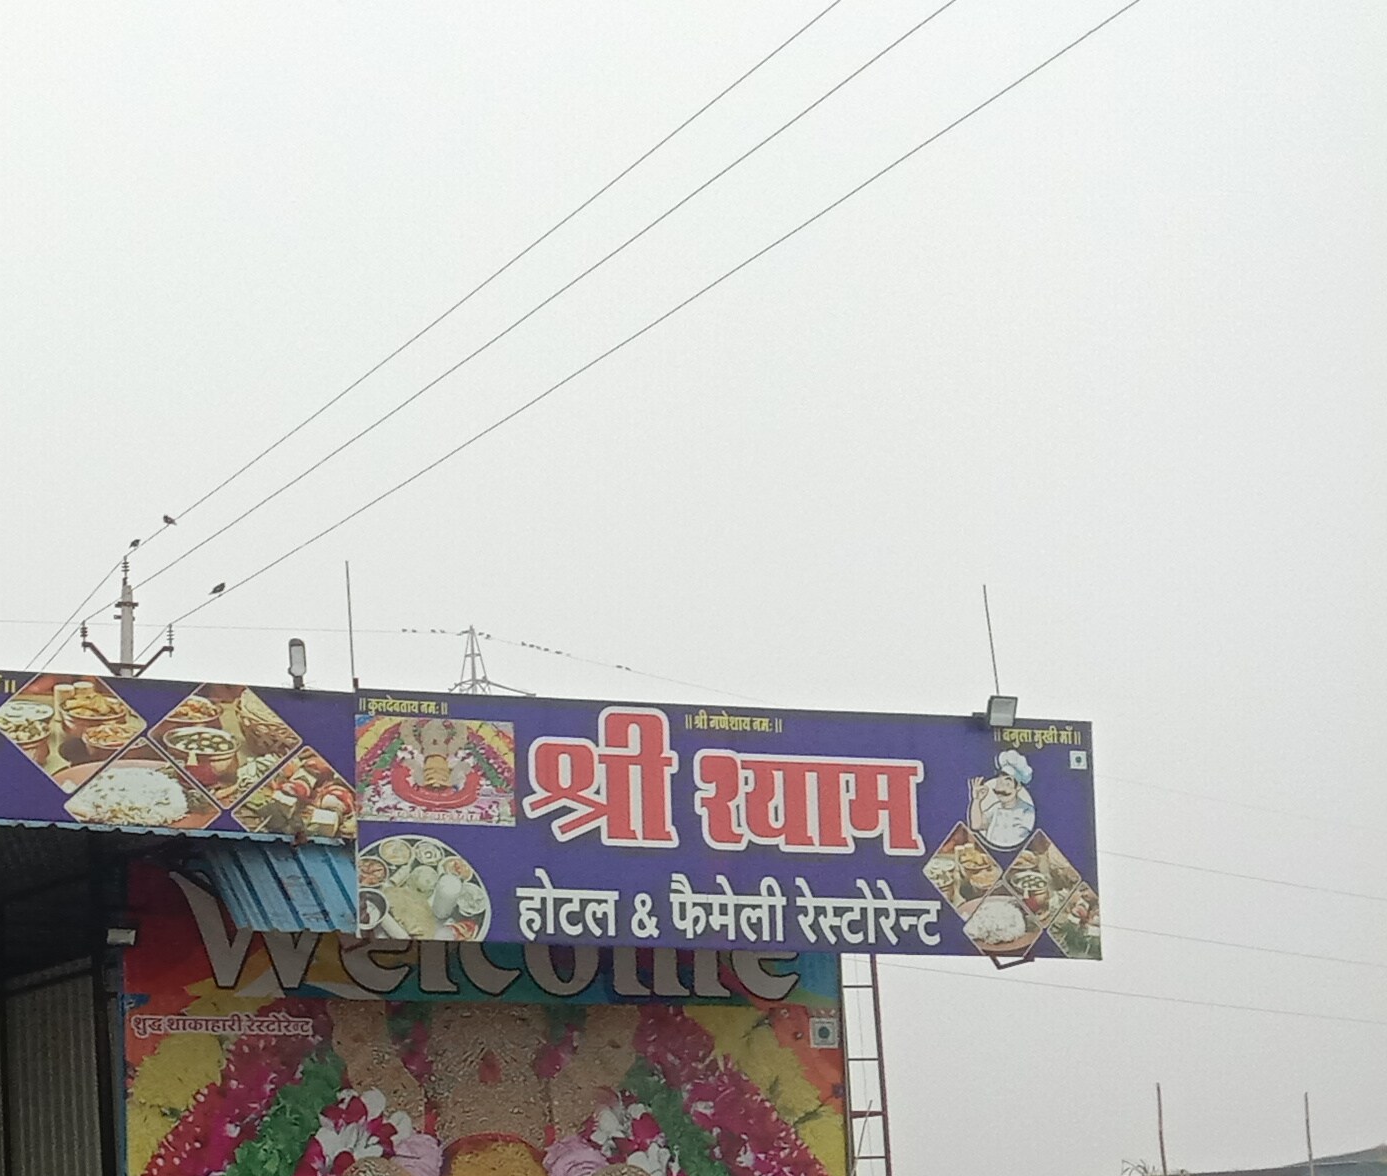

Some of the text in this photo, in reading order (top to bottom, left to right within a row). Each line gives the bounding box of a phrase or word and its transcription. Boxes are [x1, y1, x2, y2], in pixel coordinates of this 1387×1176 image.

[694, 708, 707, 730] श्री
[709, 710, 751, 731] गणेशाय
[522, 706, 926, 857] श्री श्याम
[516, 867, 942, 948] होटल & फैमेली रेस्टोरेन्ट
[167, 1014, 242, 1032] शाकाहारी
